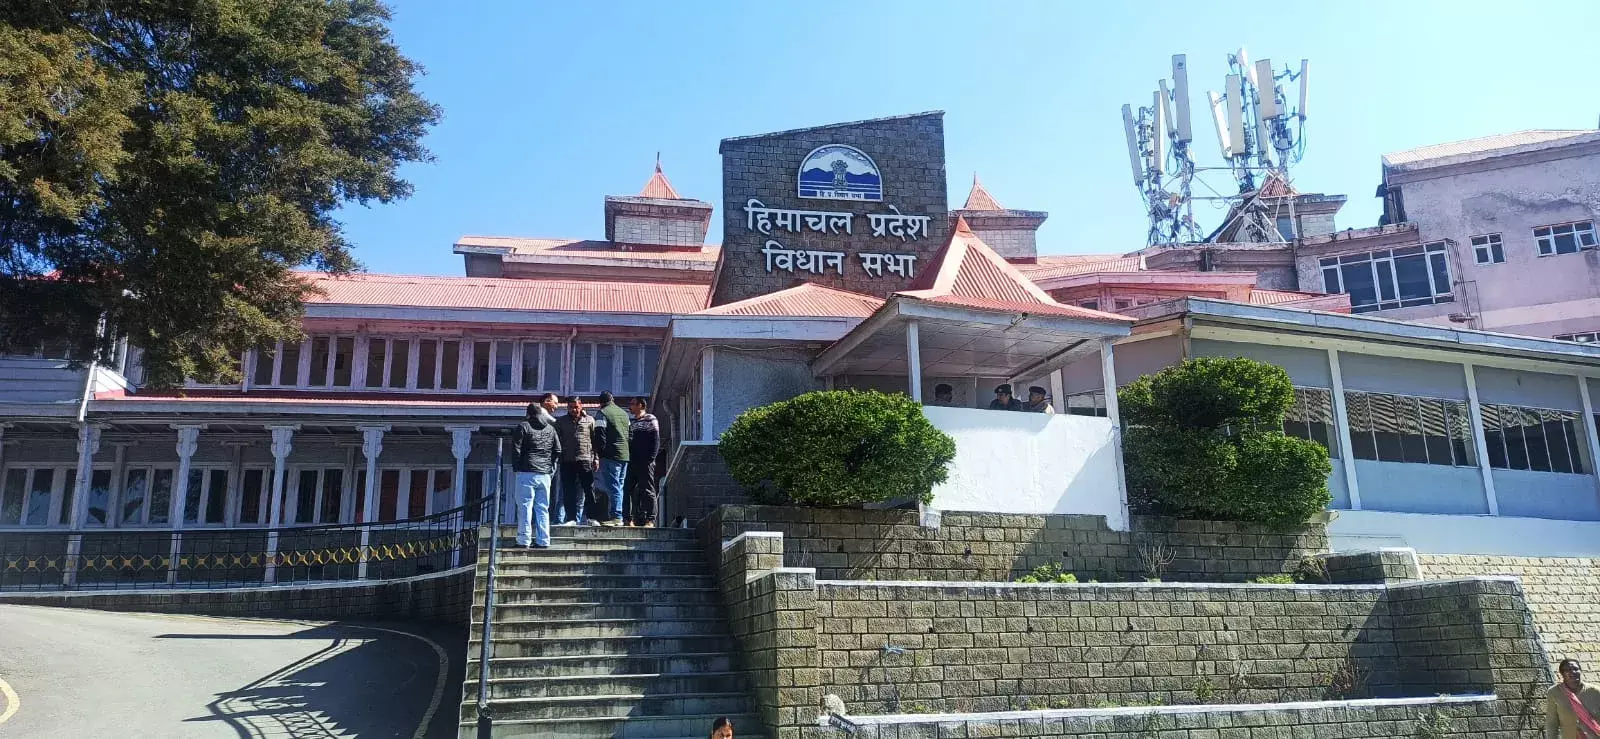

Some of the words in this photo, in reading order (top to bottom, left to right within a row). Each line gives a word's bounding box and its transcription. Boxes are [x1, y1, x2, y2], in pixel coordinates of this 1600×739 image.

[744, 199, 854, 235] हिमाचल
[867, 205, 932, 242] प्रदेश
[762, 240, 845, 275] विधान
[858, 252, 917, 278] सभा
